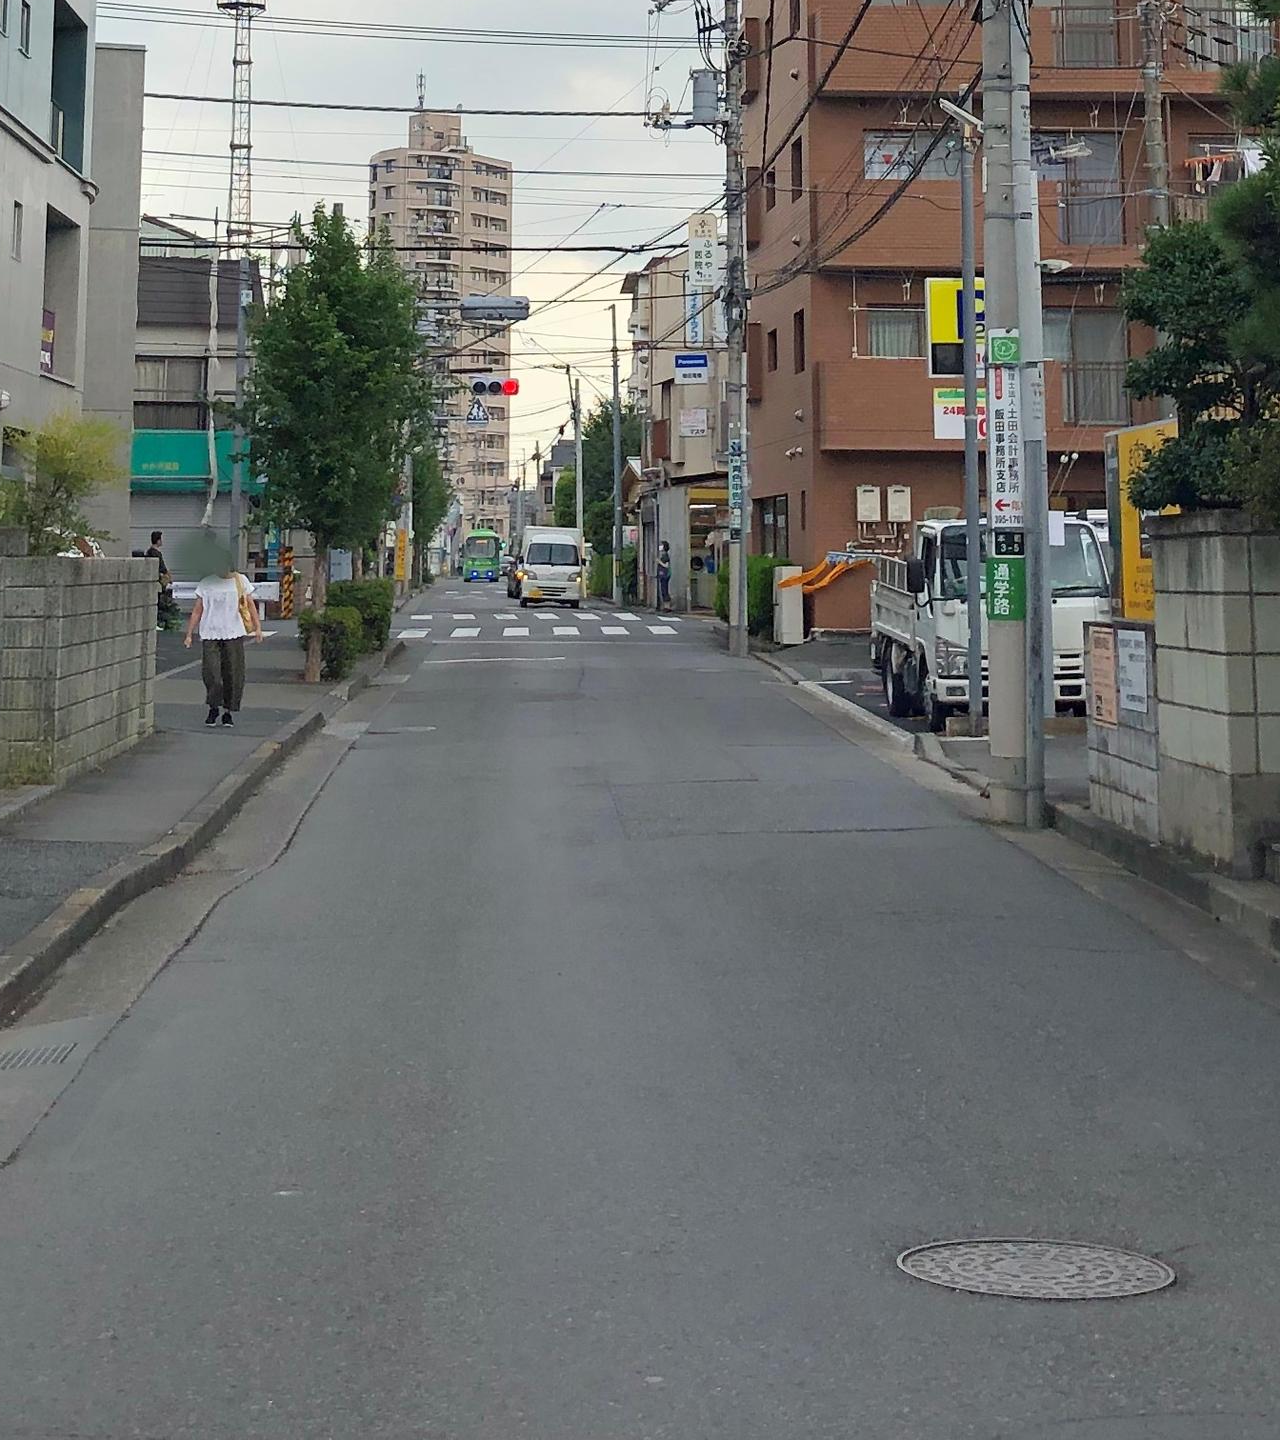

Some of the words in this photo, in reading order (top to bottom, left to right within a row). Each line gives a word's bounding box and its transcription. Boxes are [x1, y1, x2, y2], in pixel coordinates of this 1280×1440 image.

[704, 240, 713, 269] ふるや
[1000, 543, 1020, 553] 3-5
[993, 563, 1010, 615] 通学路
